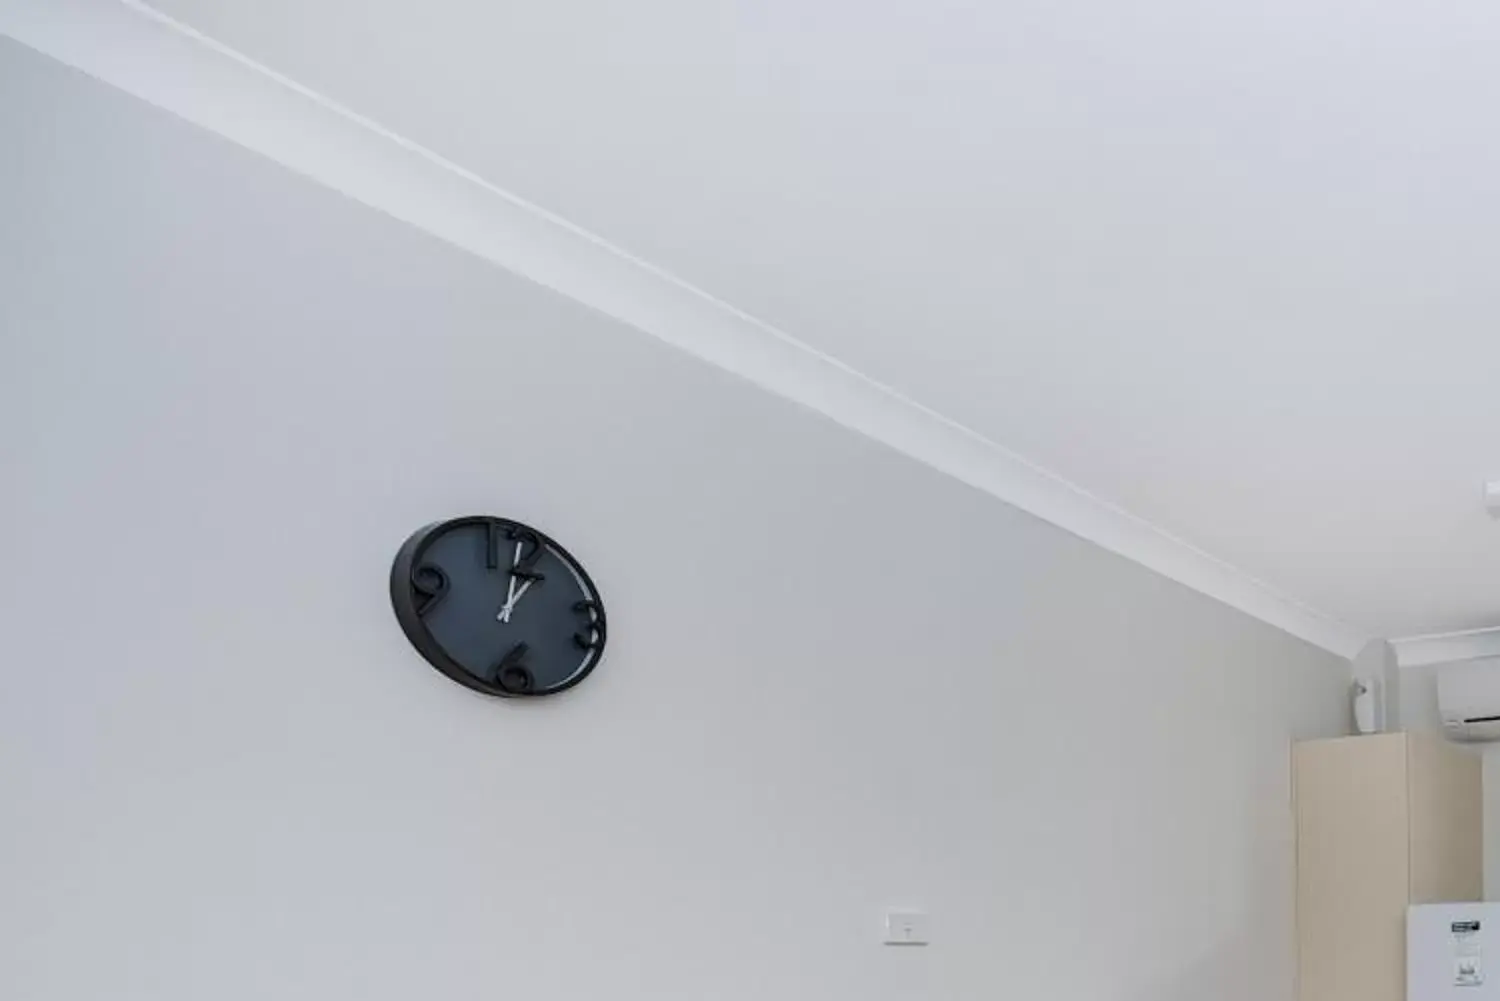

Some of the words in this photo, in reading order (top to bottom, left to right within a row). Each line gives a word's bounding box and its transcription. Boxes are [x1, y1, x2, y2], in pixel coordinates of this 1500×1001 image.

[483, 521, 545, 580] 12
[414, 567, 447, 616] 9
[573, 599, 603, 650] 3
[496, 641, 530, 690] 6
